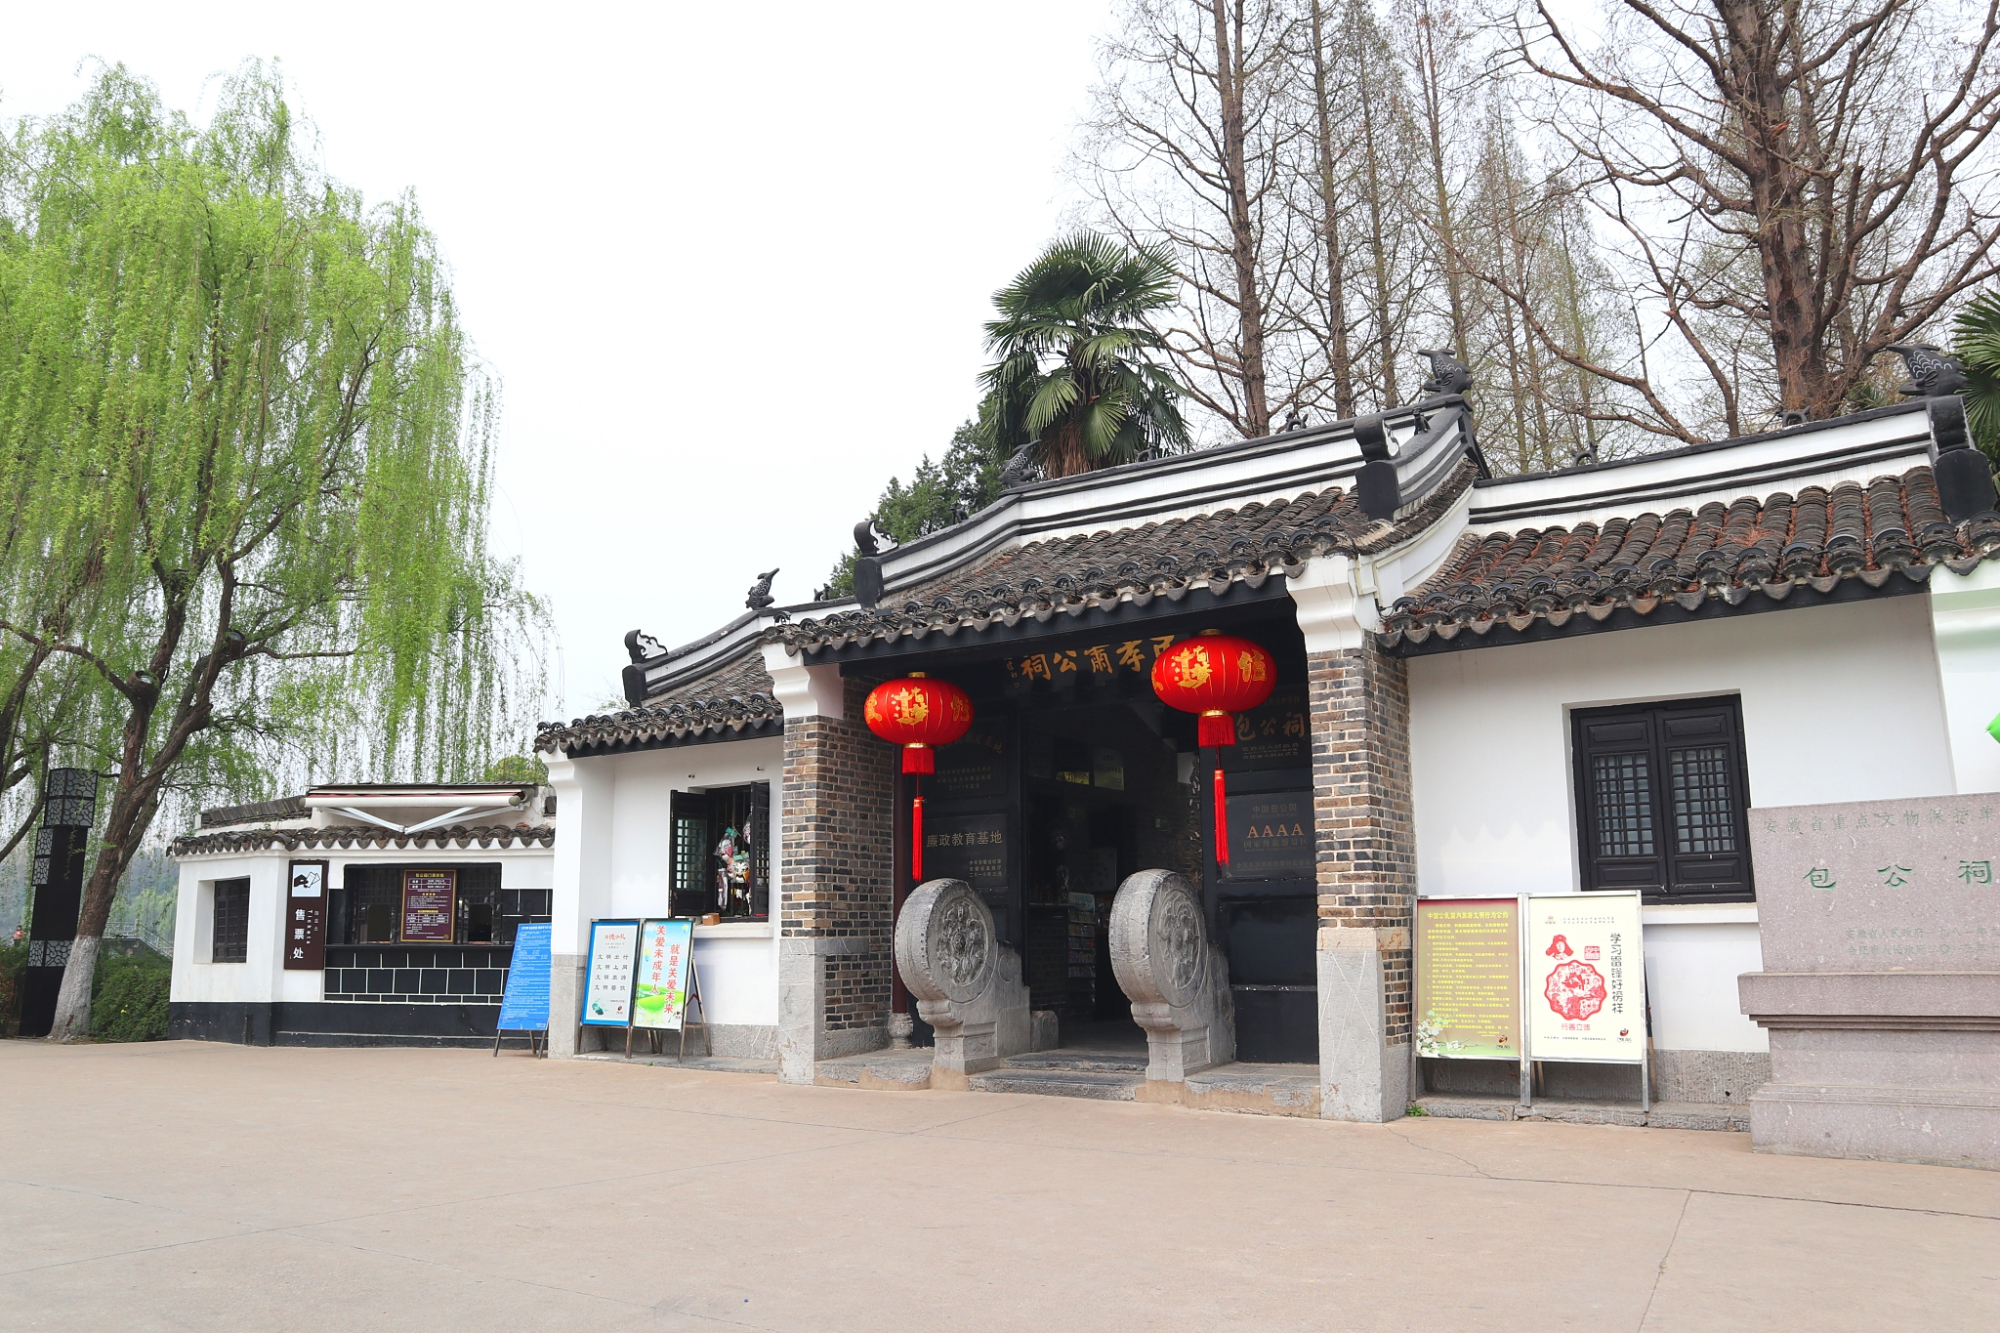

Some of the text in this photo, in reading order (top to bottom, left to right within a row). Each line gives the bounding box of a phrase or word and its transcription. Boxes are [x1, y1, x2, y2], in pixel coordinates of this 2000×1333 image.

[1235, 711, 1305, 741] 包公祠
[926, 830, 1003, 848] 廉政教育基地
[1246, 822, 1304, 839] AAAA
[1802, 860, 1994, 890] 包公祠
[293, 909, 306, 959] 售票处
[649, 925, 666, 995] 关爱未成年人
[663, 944, 681, 1014] 就是关爱未来
[1610, 932, 1624, 1014] 学习雷锋好榜样
